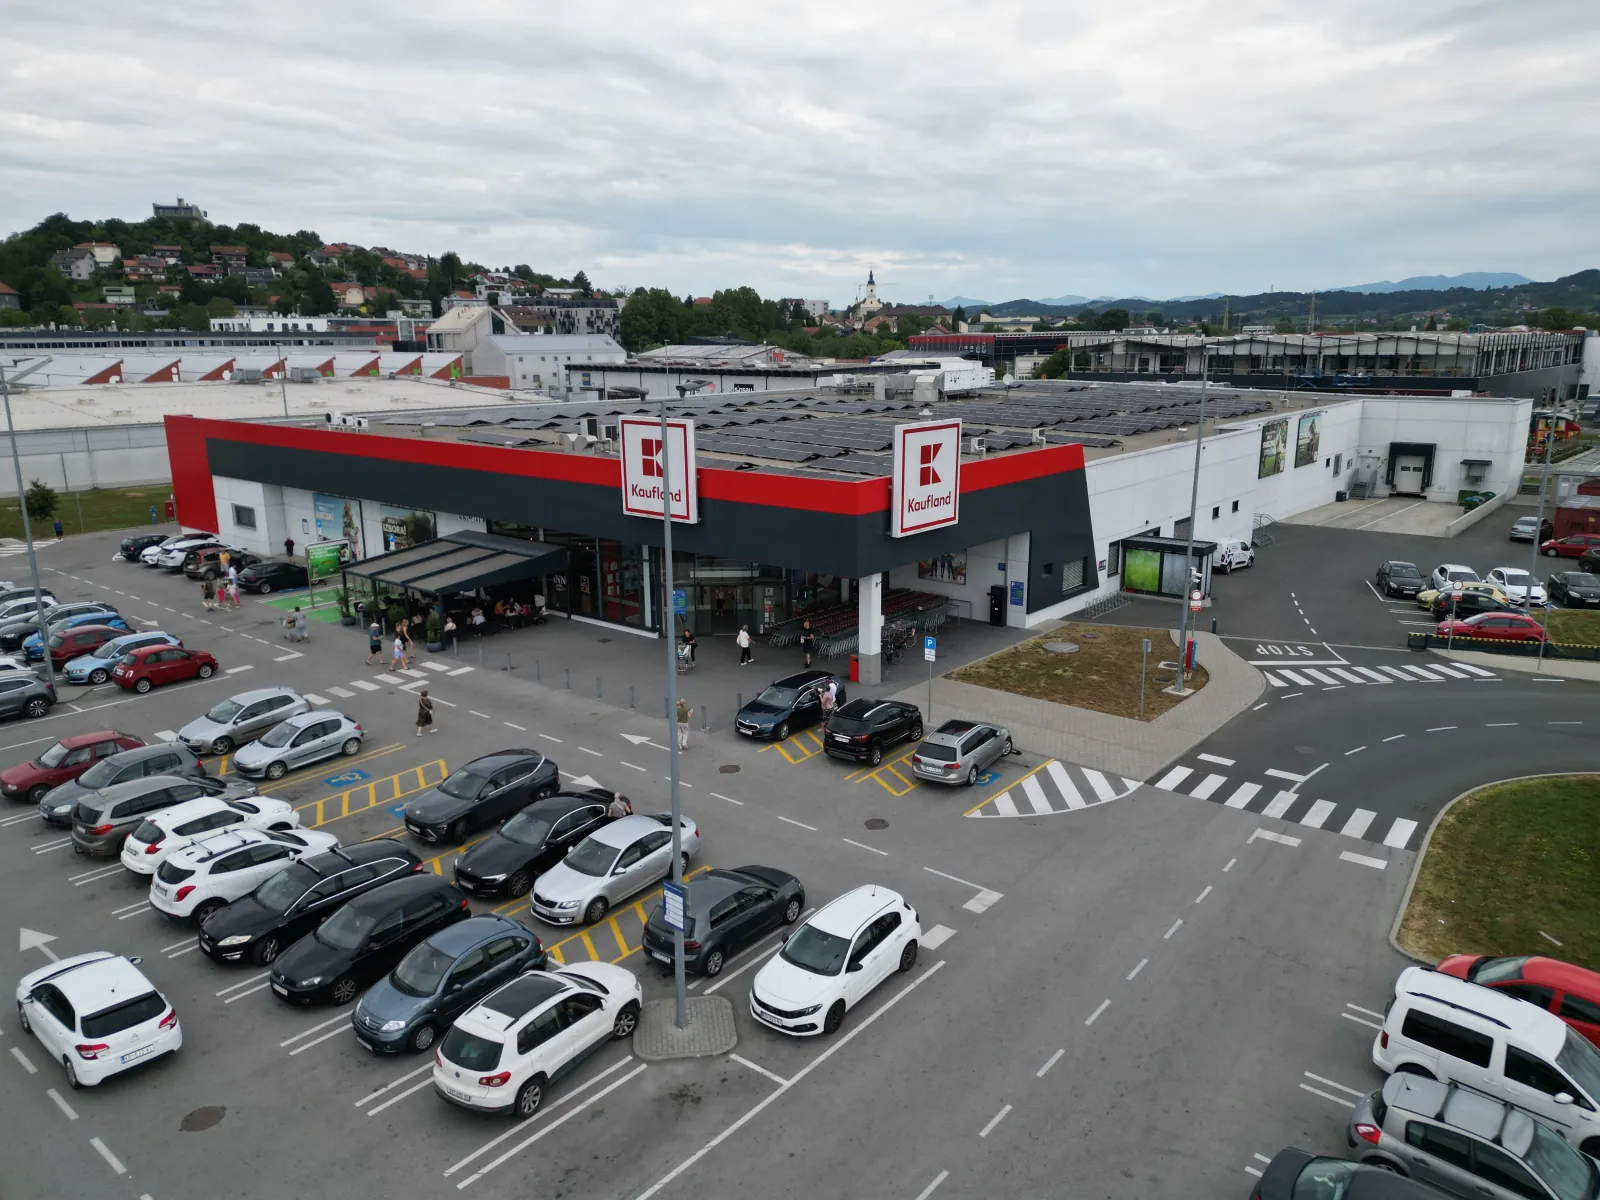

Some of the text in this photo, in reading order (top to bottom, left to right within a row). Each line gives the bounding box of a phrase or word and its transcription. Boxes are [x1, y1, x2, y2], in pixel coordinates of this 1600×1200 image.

[907, 490, 951, 513] Kaufland
[927, 639, 933, 647] P
[1256, 644, 1314, 657] STOP
